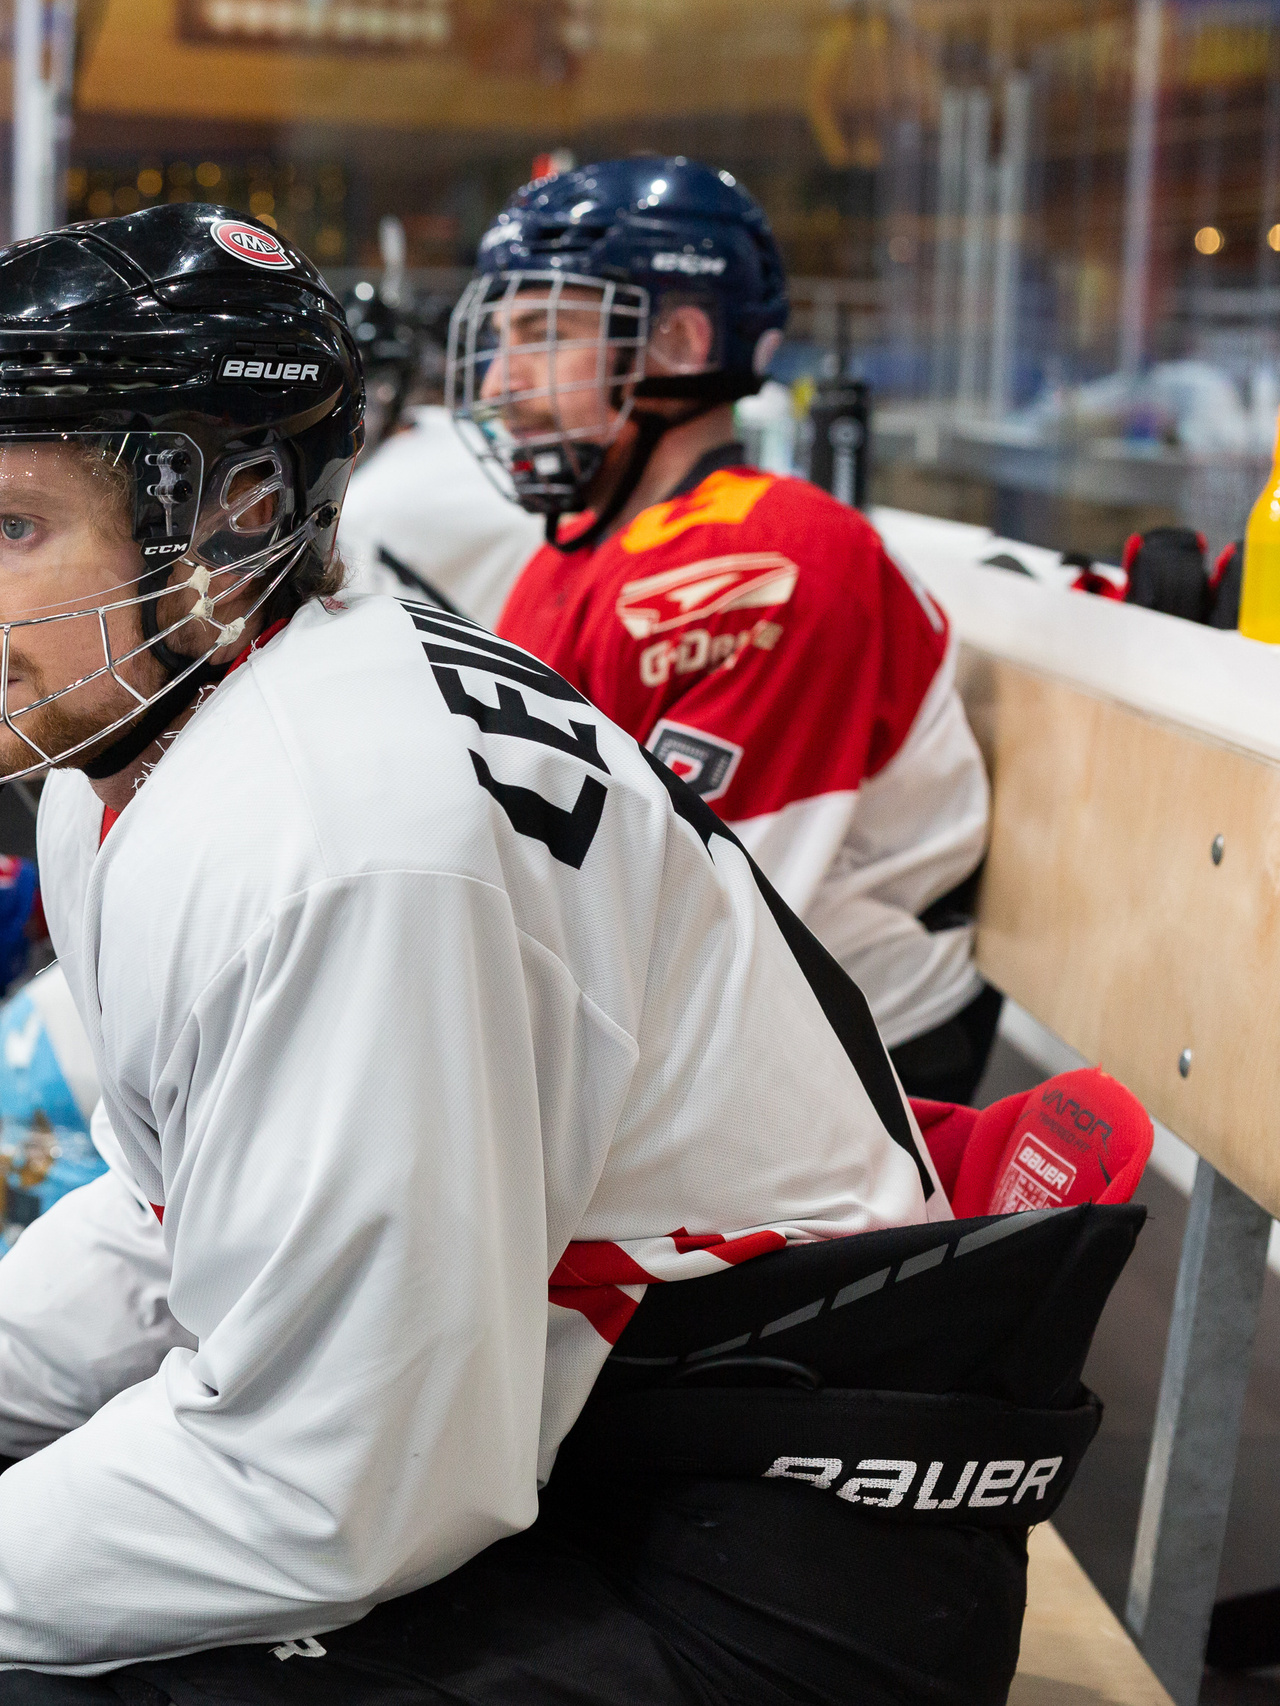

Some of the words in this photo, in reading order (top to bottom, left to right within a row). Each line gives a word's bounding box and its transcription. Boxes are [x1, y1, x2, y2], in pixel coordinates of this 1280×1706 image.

[223, 360, 320, 381] BAUER
[144, 543, 188, 555] CCM
[1041, 1087, 1113, 1153] VAPOR
[1018, 1146, 1068, 1190] BAUER
